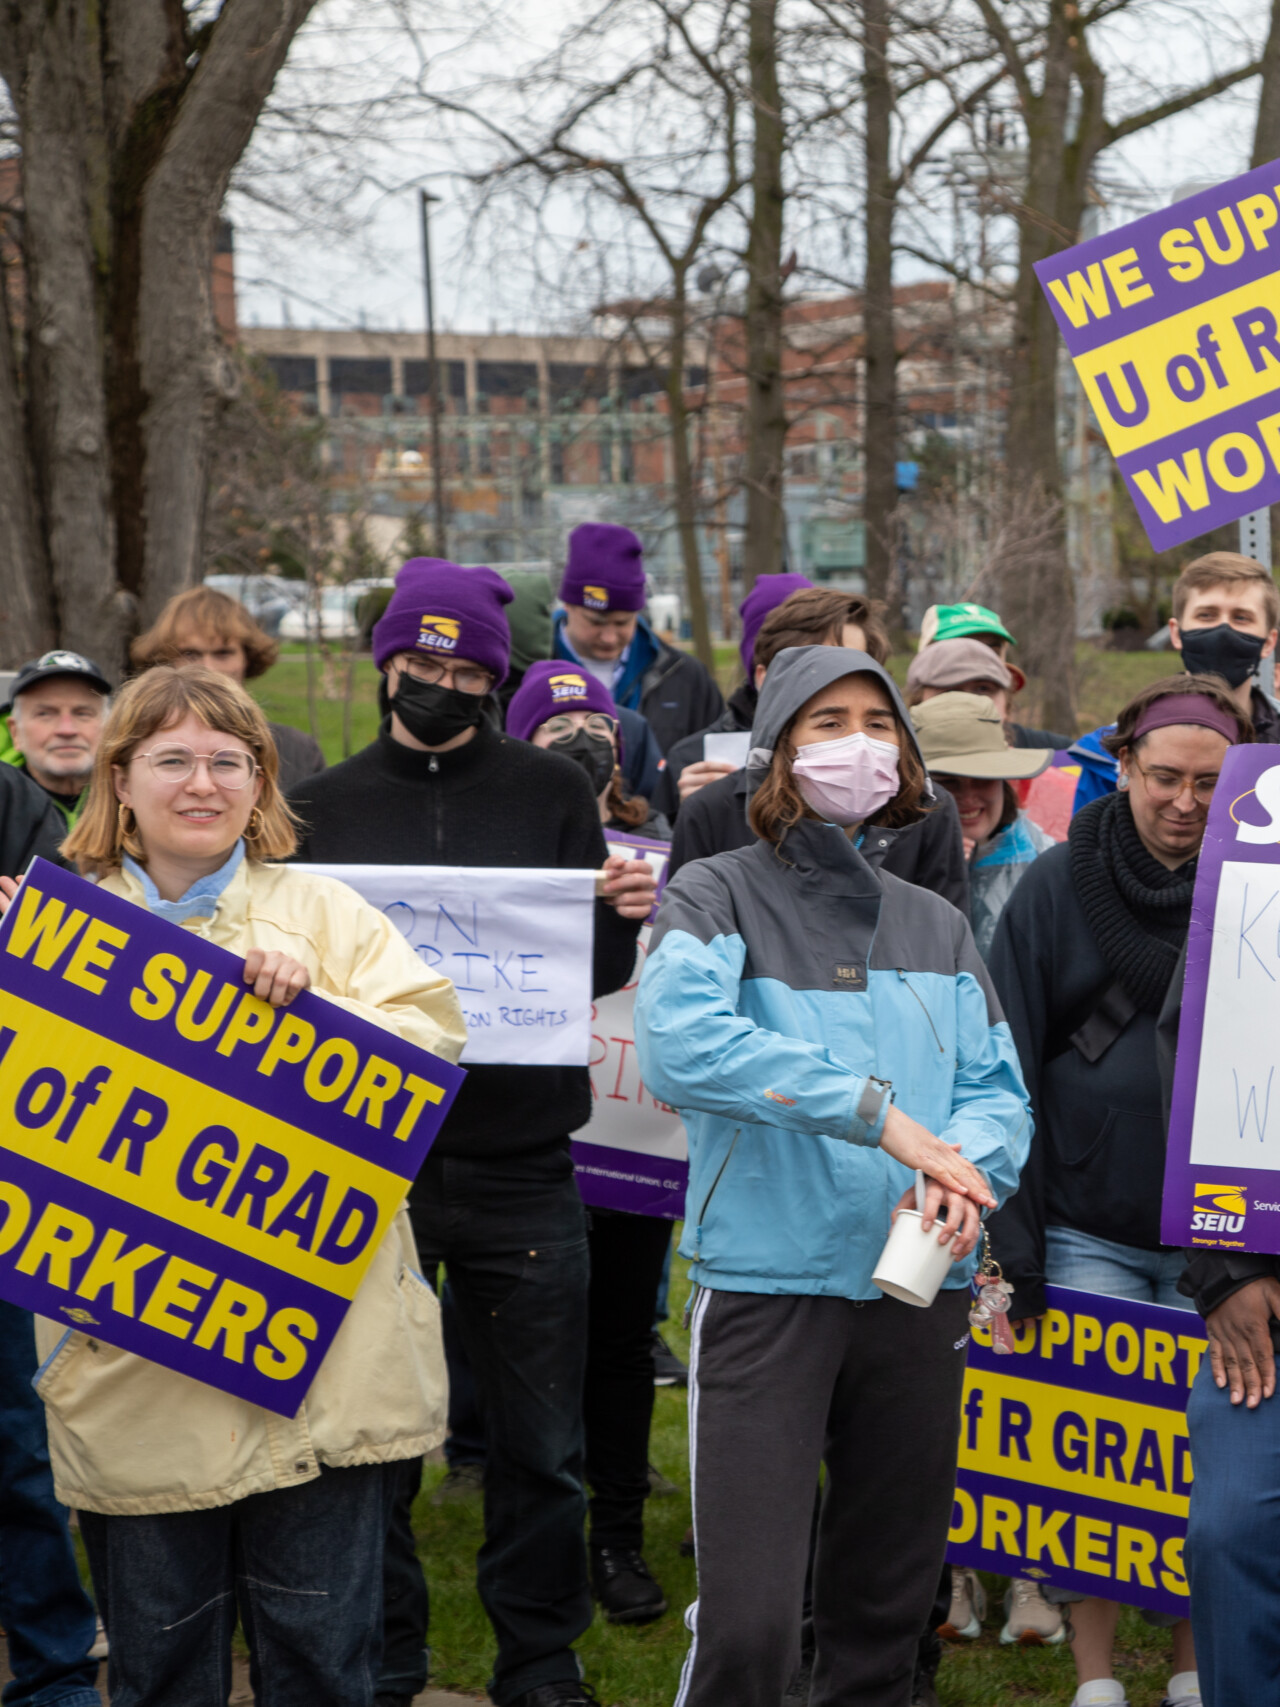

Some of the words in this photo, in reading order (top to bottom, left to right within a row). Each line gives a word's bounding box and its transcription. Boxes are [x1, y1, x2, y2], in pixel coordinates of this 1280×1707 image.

[1047, 248, 1154, 329] WE
[1094, 361, 1150, 428] U
[1166, 324, 1229, 403] of
[416, 633, 457, 649] SEIU
[552, 686, 587, 698] SEIU
[382, 900, 478, 948] ON
[5, 886, 131, 995] WE
[130, 953, 446, 1142] SUPPORT
[498, 1006, 568, 1027] RIGHTS
[14, 1064, 113, 1144] of
[97, 1087, 169, 1176] R
[175, 1125, 379, 1266] GRAD
[1190, 1213, 1245, 1233] SEIU
[999, 1397, 1032, 1462] R
